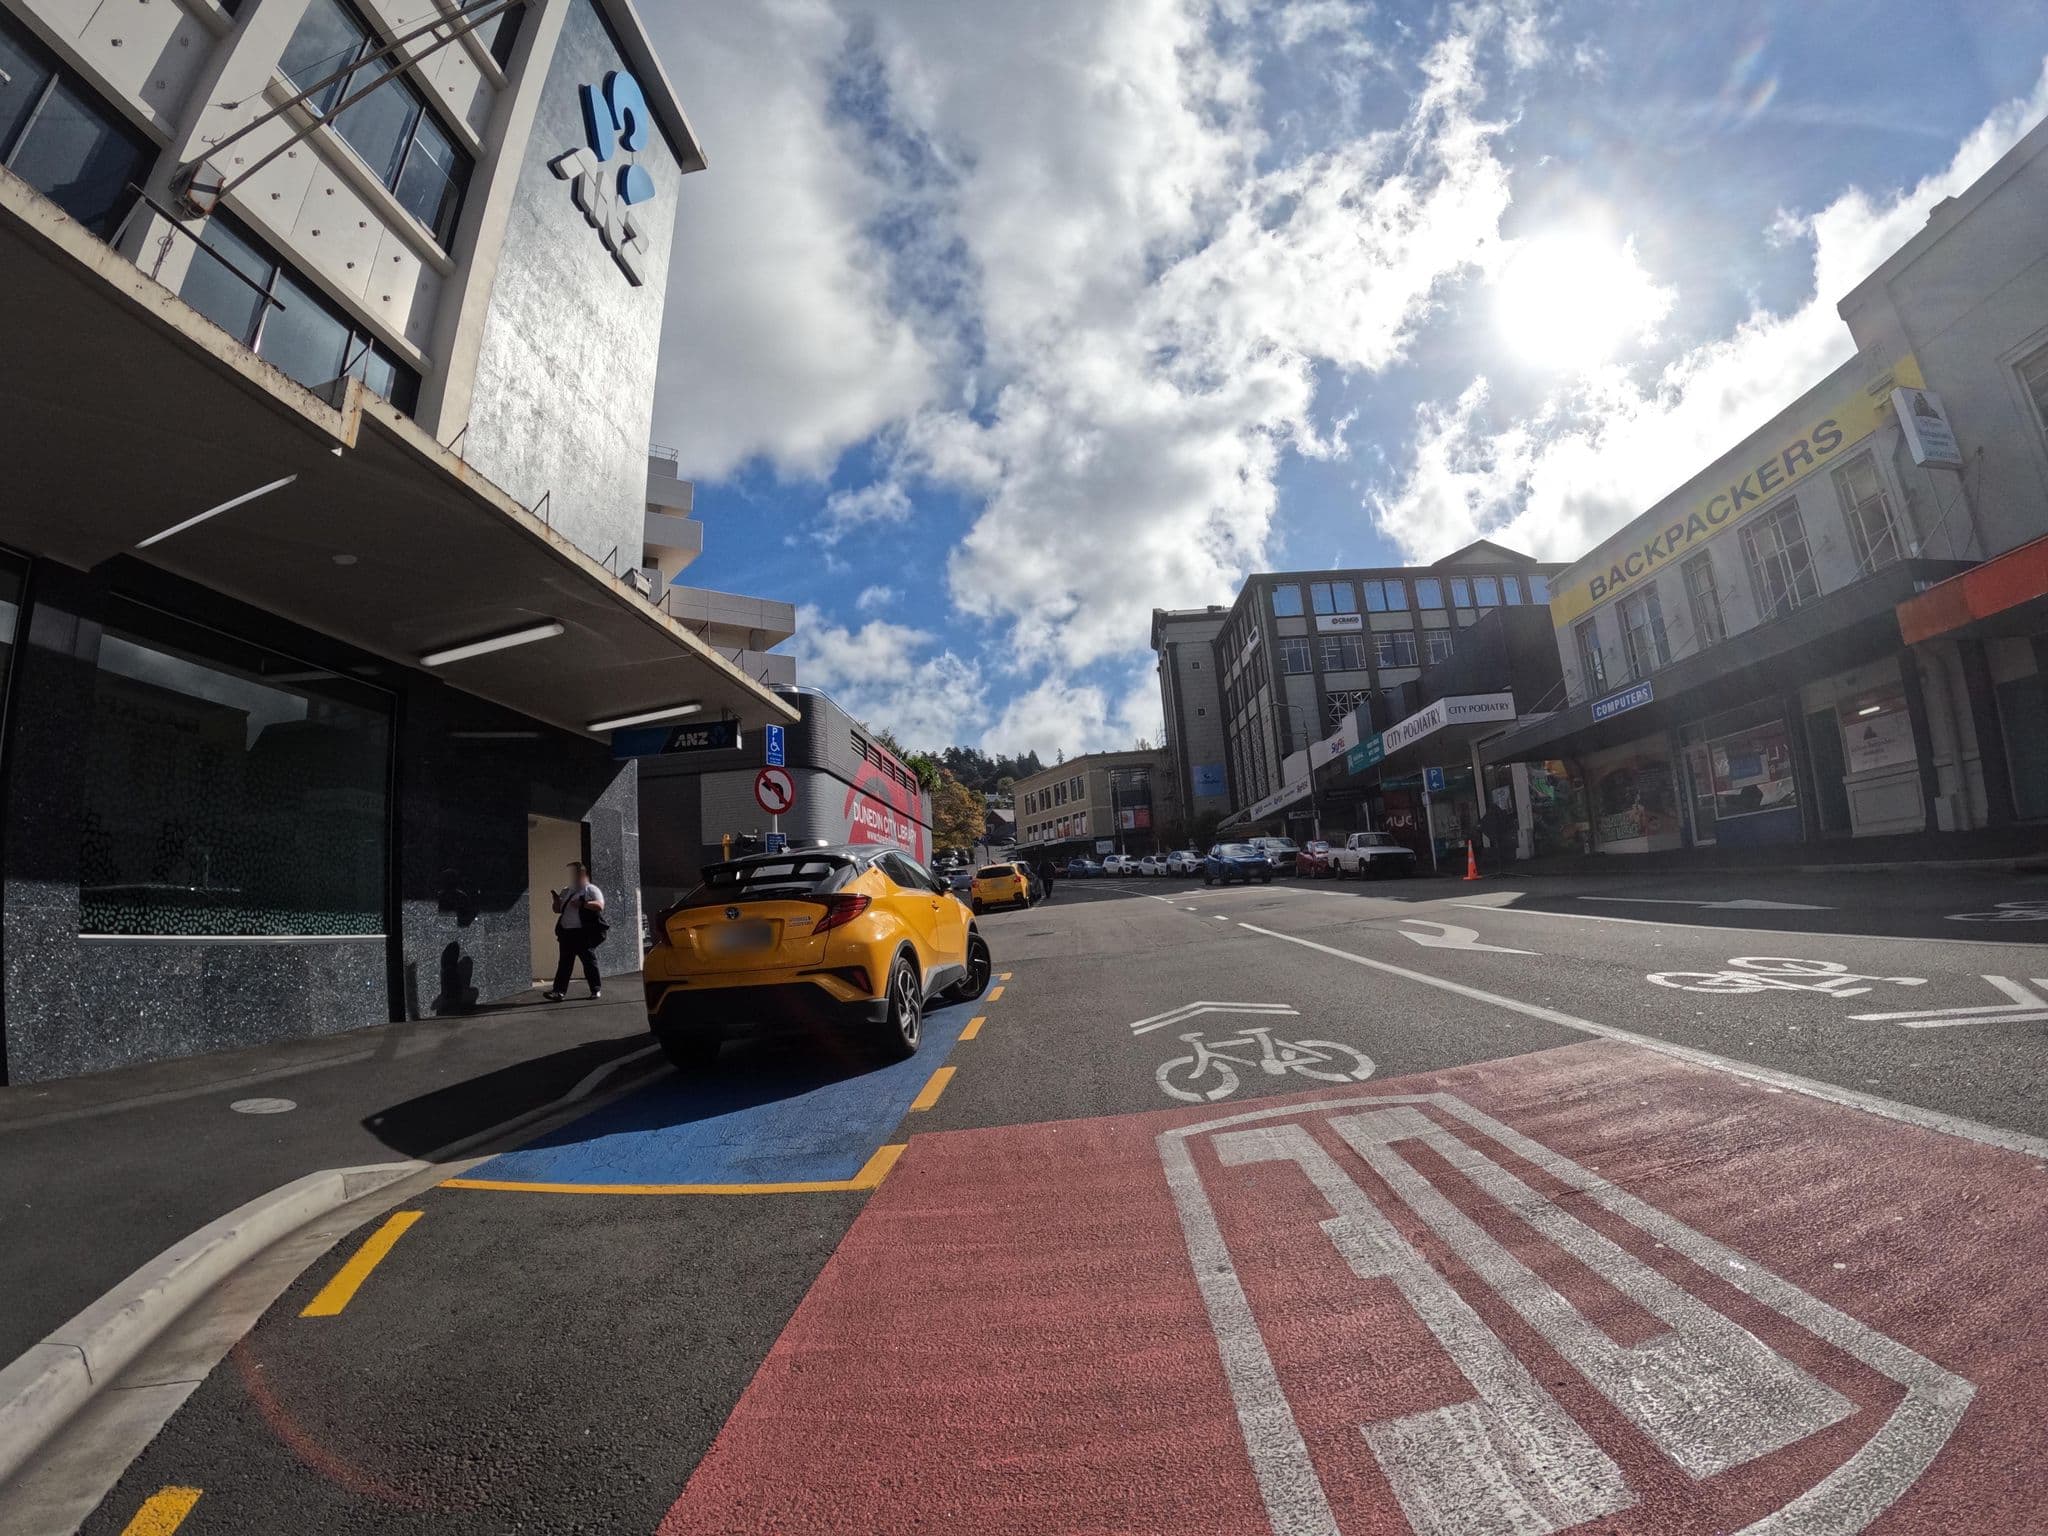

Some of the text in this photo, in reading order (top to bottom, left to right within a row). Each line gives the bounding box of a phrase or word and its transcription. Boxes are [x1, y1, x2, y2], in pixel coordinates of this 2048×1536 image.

[1588, 419, 1843, 602] BACKPACKERS
[1448, 702, 1510, 715] CITY PODIATRY
[1596, 688, 1649, 717] COMPUTERS
[772, 727, 778, 736] P
[1386, 706, 1441, 749] CITY PODIATRY
[674, 731, 709, 747] ANZ
[1431, 769, 1438, 781] P
[853, 801, 884, 831] DUNEDIN
[883, 815, 898, 842] CITY
